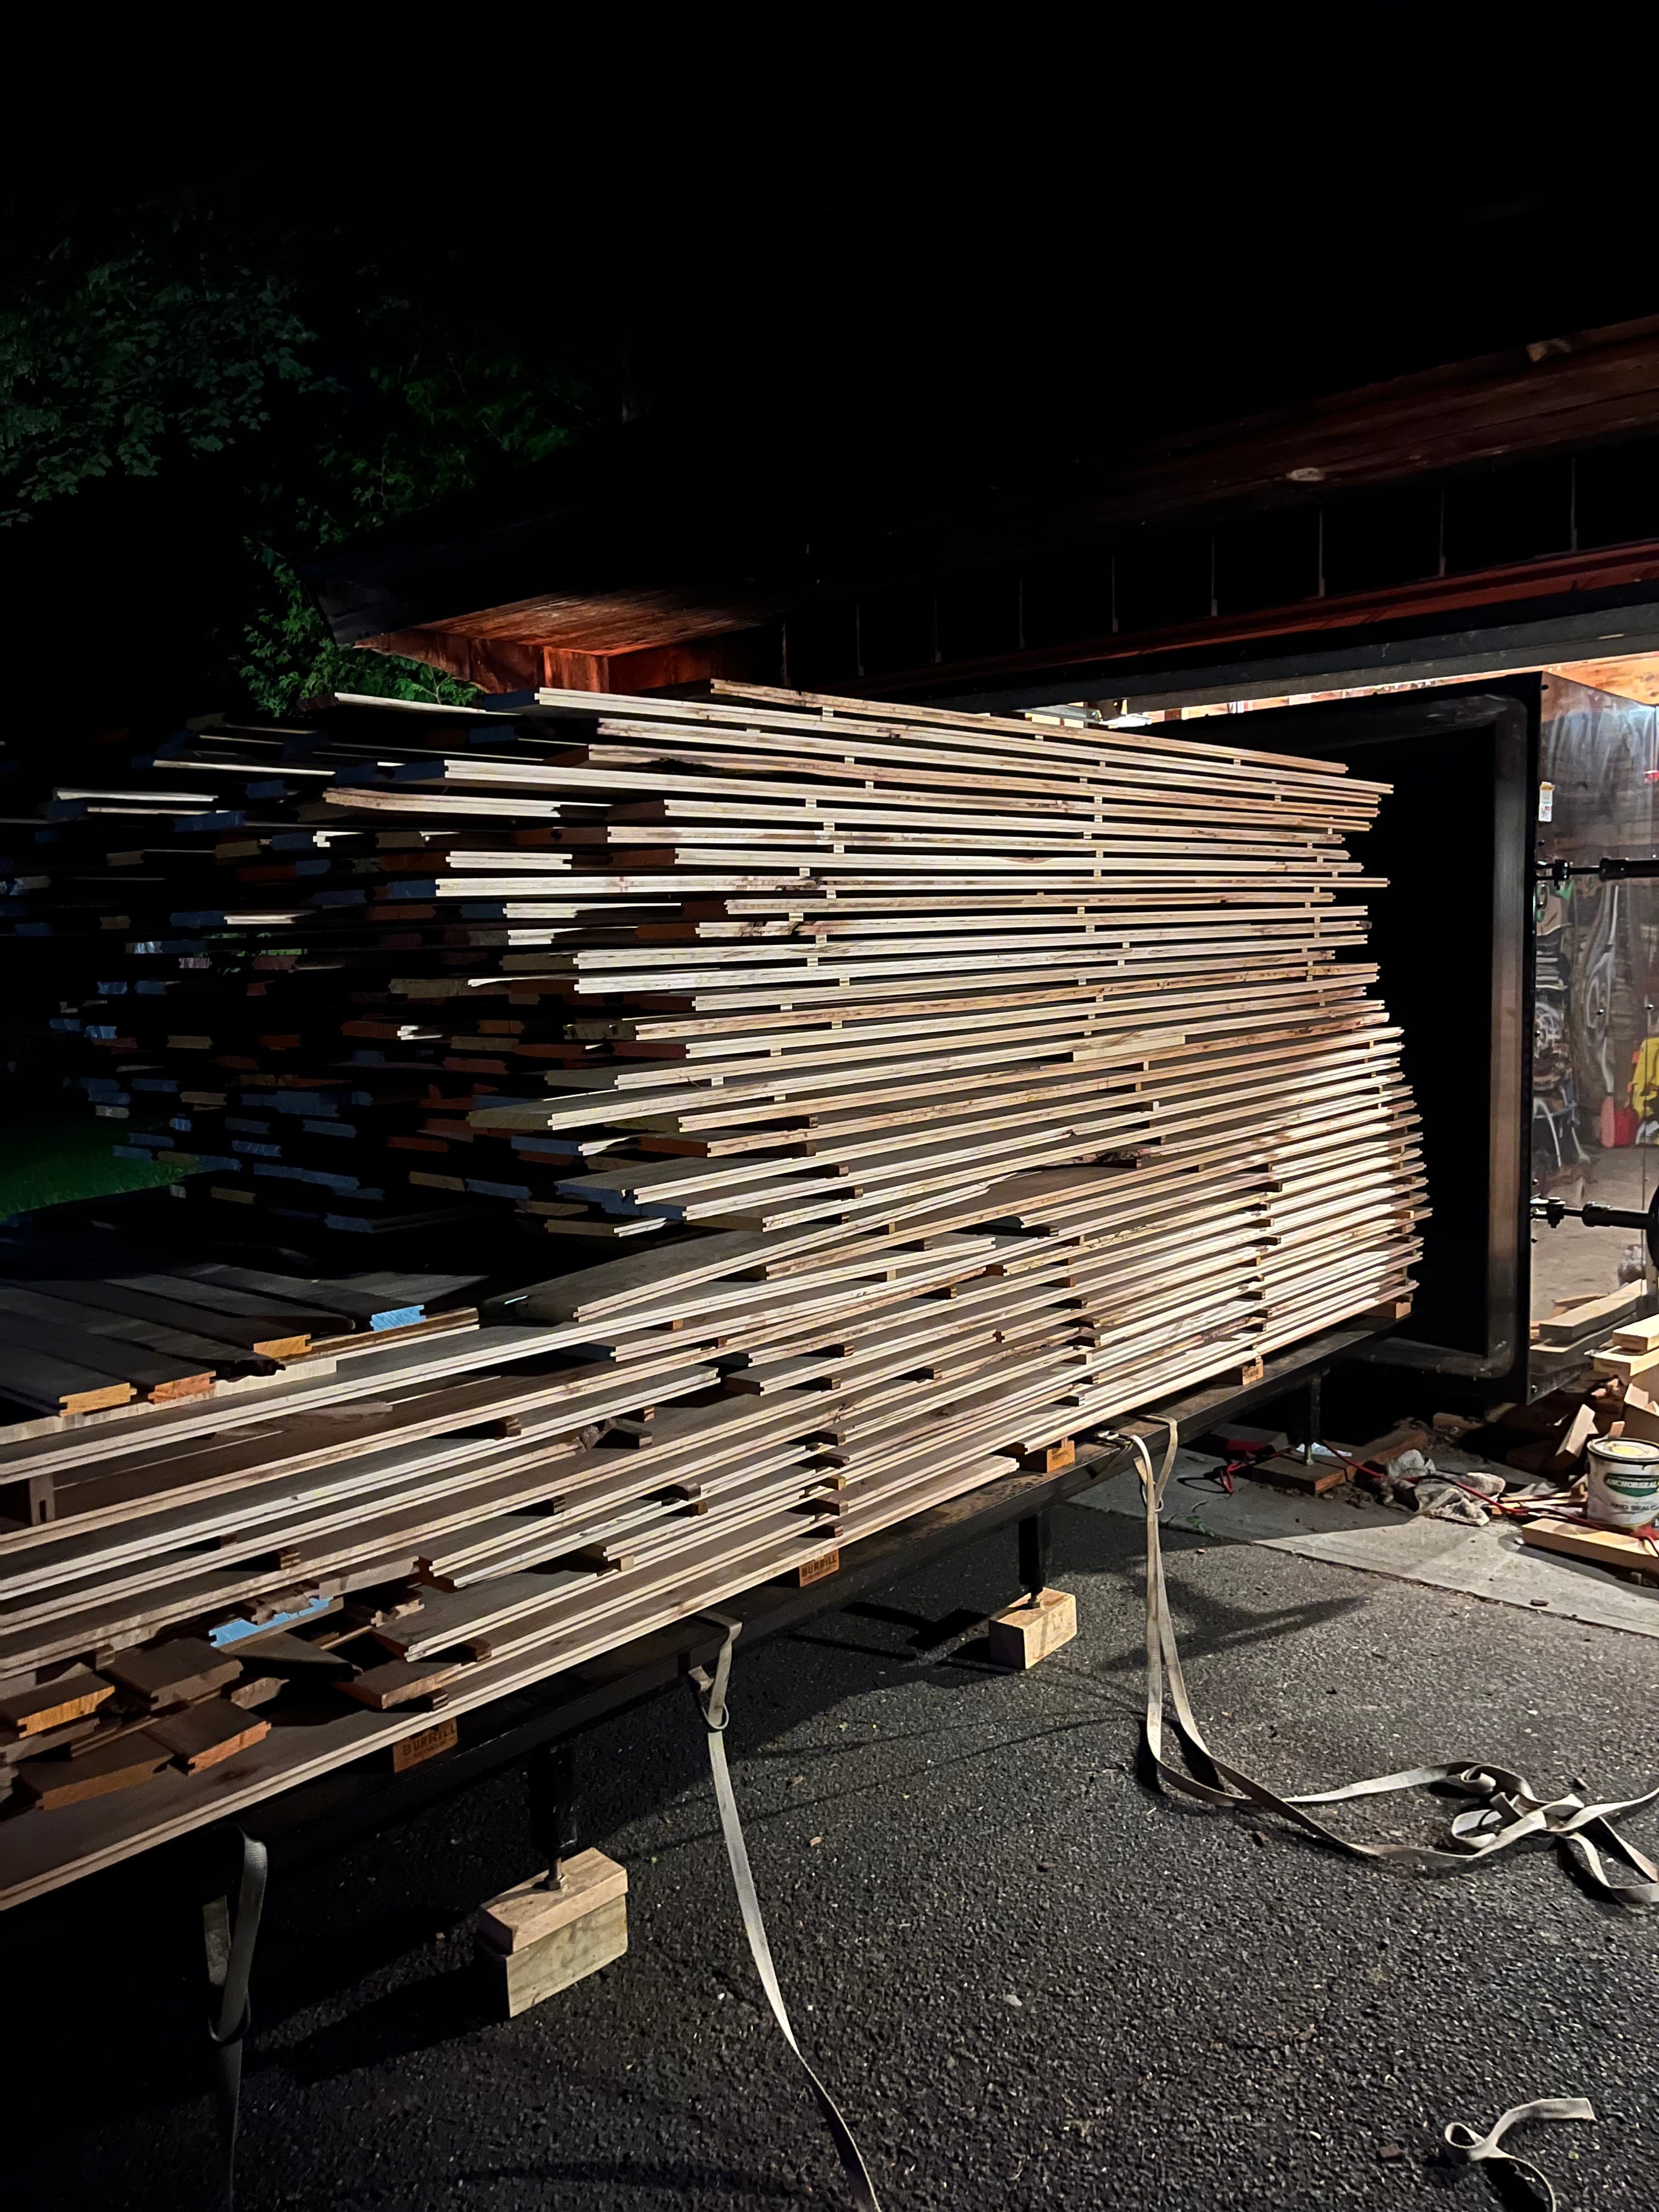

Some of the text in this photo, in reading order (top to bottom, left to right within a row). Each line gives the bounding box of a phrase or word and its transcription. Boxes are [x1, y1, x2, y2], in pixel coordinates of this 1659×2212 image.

[1605, 1478, 1657, 1488] ANCHORSEAL
[802, 1554, 837, 1577] BURRILL
[403, 1723, 456, 1756] BURRILL
